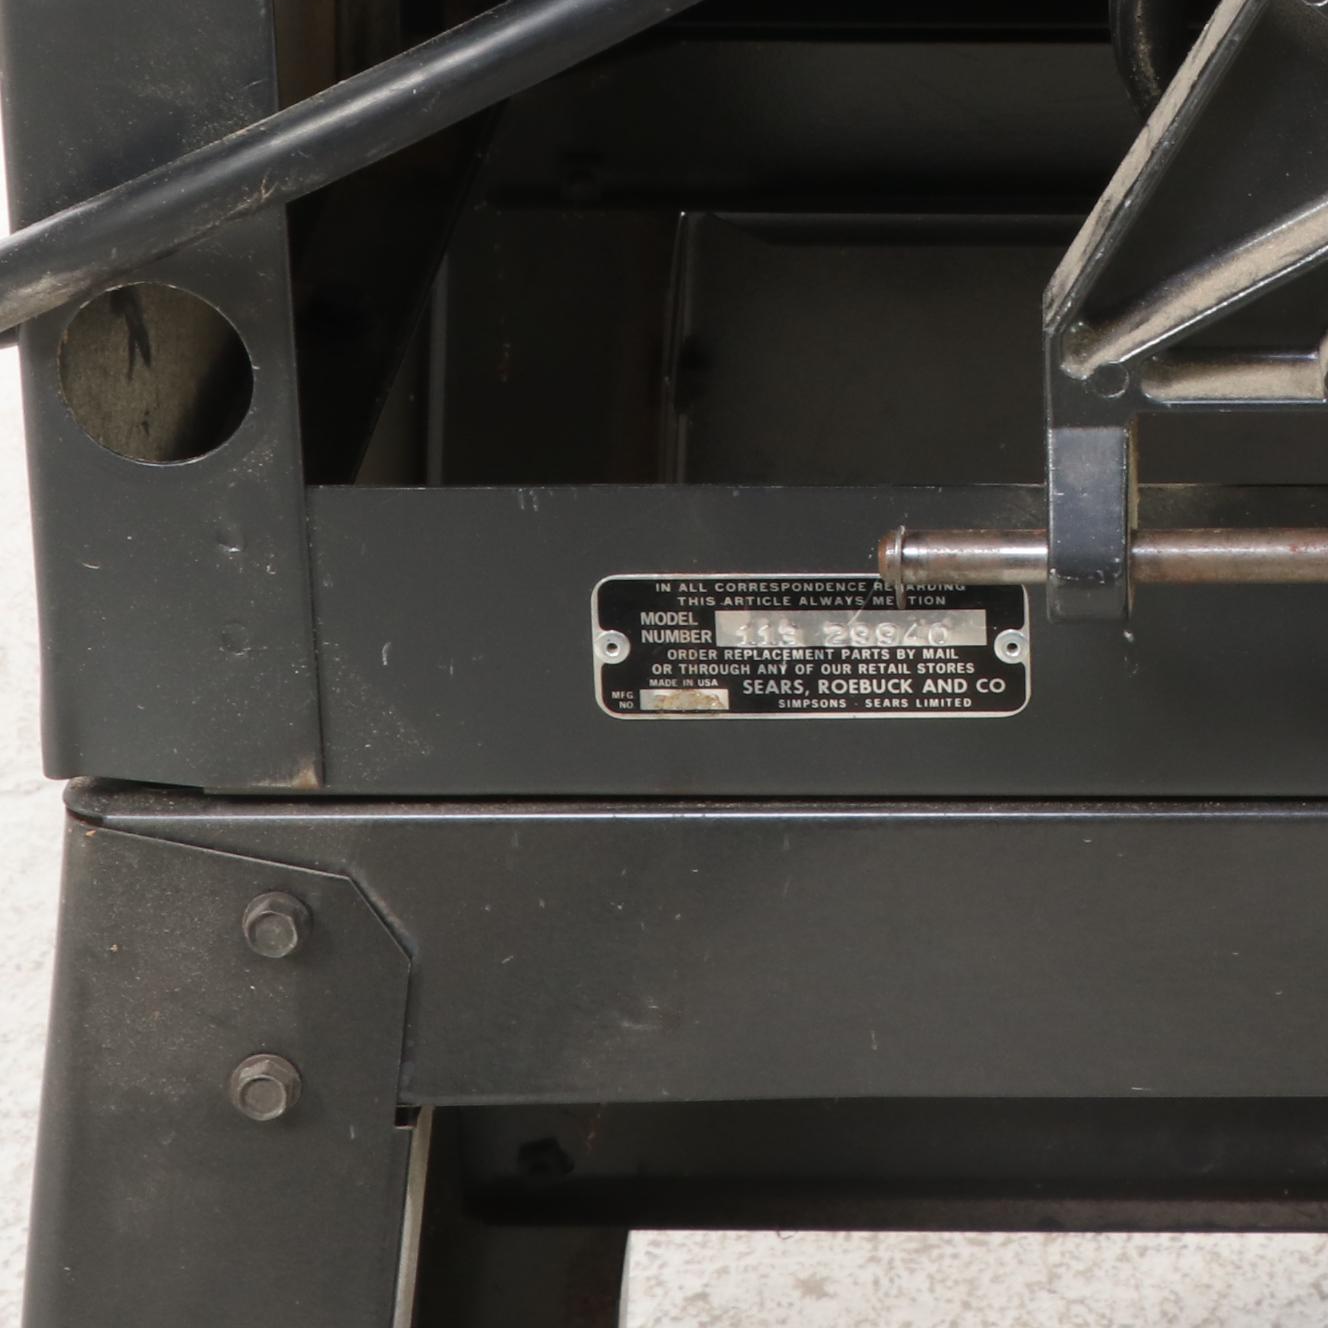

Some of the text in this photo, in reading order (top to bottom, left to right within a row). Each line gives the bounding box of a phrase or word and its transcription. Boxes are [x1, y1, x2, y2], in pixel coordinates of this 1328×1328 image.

[655, 582, 966, 592] IN ALL CORRESPONDENCE REARDING
[677, 595, 946, 606] THIS ARTICLE ALWAYS METION
[640, 611, 698, 626] MODEL
[641, 629, 712, 643] NUMBER
[667, 648, 959, 660] ORDER REPLACEMENT PARTS BY MAIL
[651, 663, 975, 675] OR THROUGH ANY OF OUR RETAIL STORES
[649, 679, 719, 687] MADE IN USA
[742, 678, 1006, 697] SEARS, ROEBUCK AND CO
[611, 691, 634, 700] MFG
[618, 701, 634, 709] NO
[778, 699, 847, 708] SIMPSONS
[865, 698, 909, 708] SEARS
[916, 698, 972, 708] LIMITED
